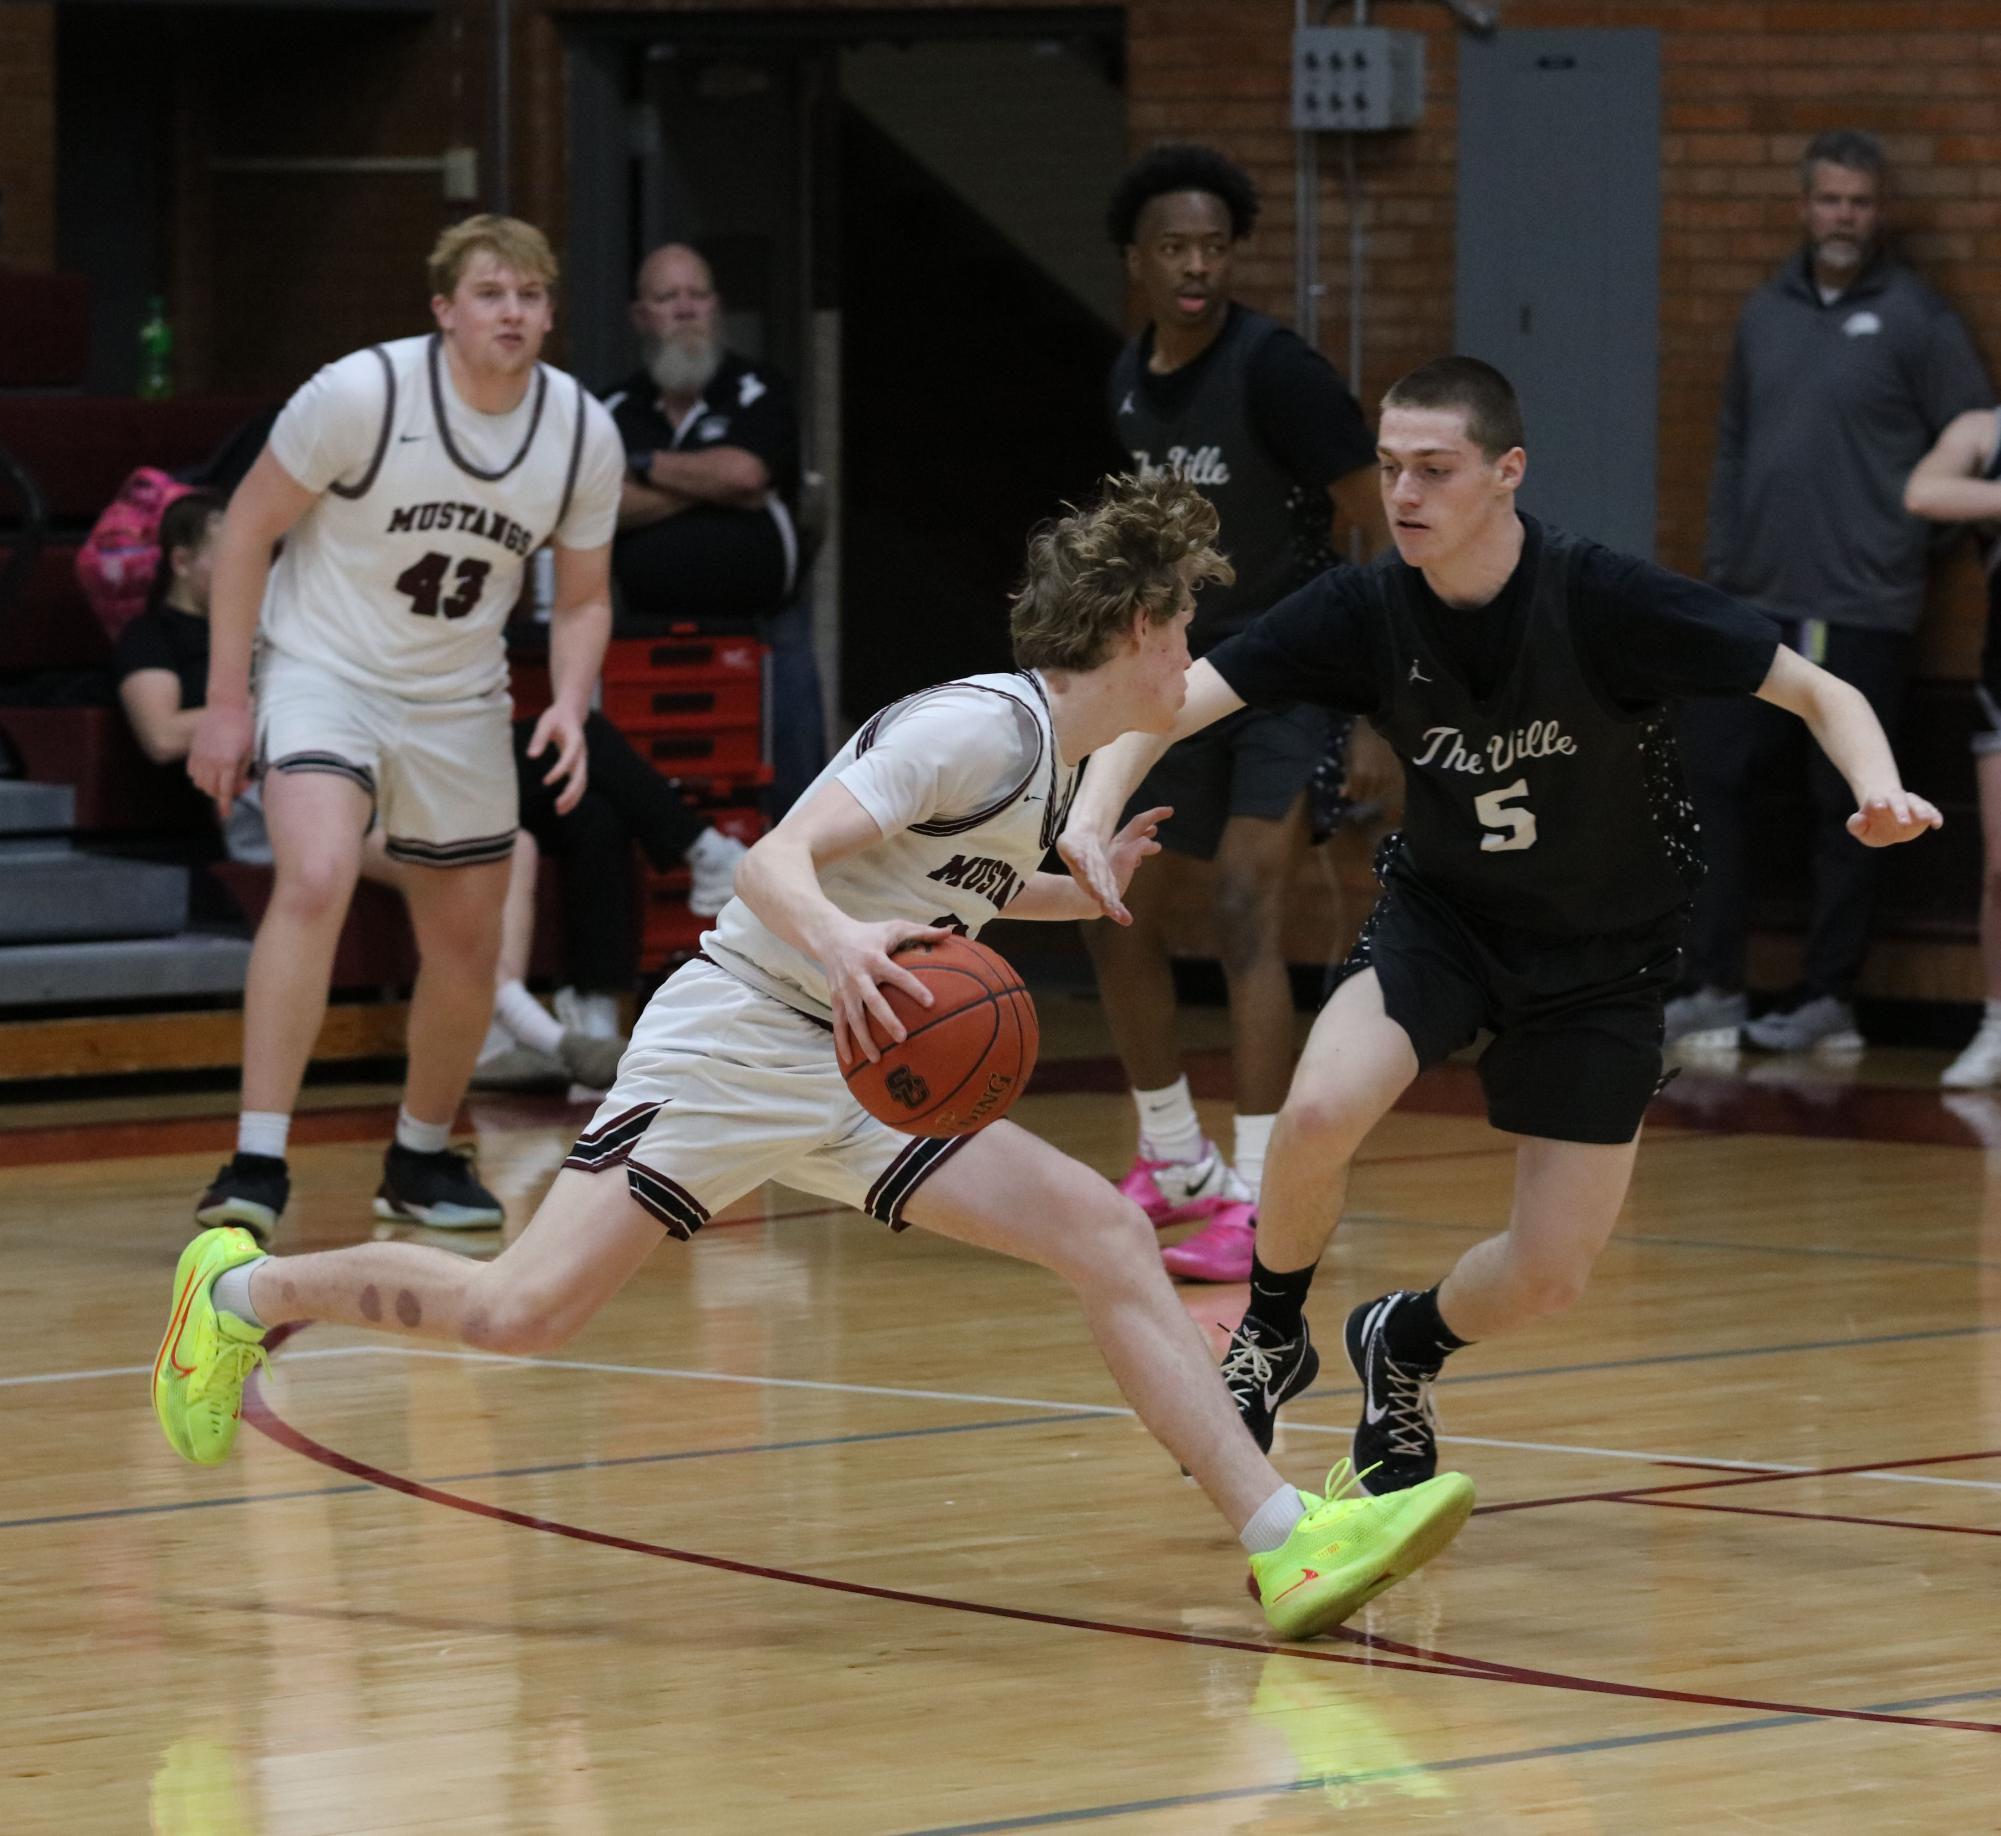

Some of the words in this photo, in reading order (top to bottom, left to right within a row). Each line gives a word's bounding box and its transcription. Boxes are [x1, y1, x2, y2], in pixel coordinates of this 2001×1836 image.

[386, 502, 532, 556] MUSTANGS
[395, 551, 492, 620] 43
[1412, 726, 1485, 774] The
[1486, 720, 1578, 773] Ville
[1474, 778, 1537, 852] 5
